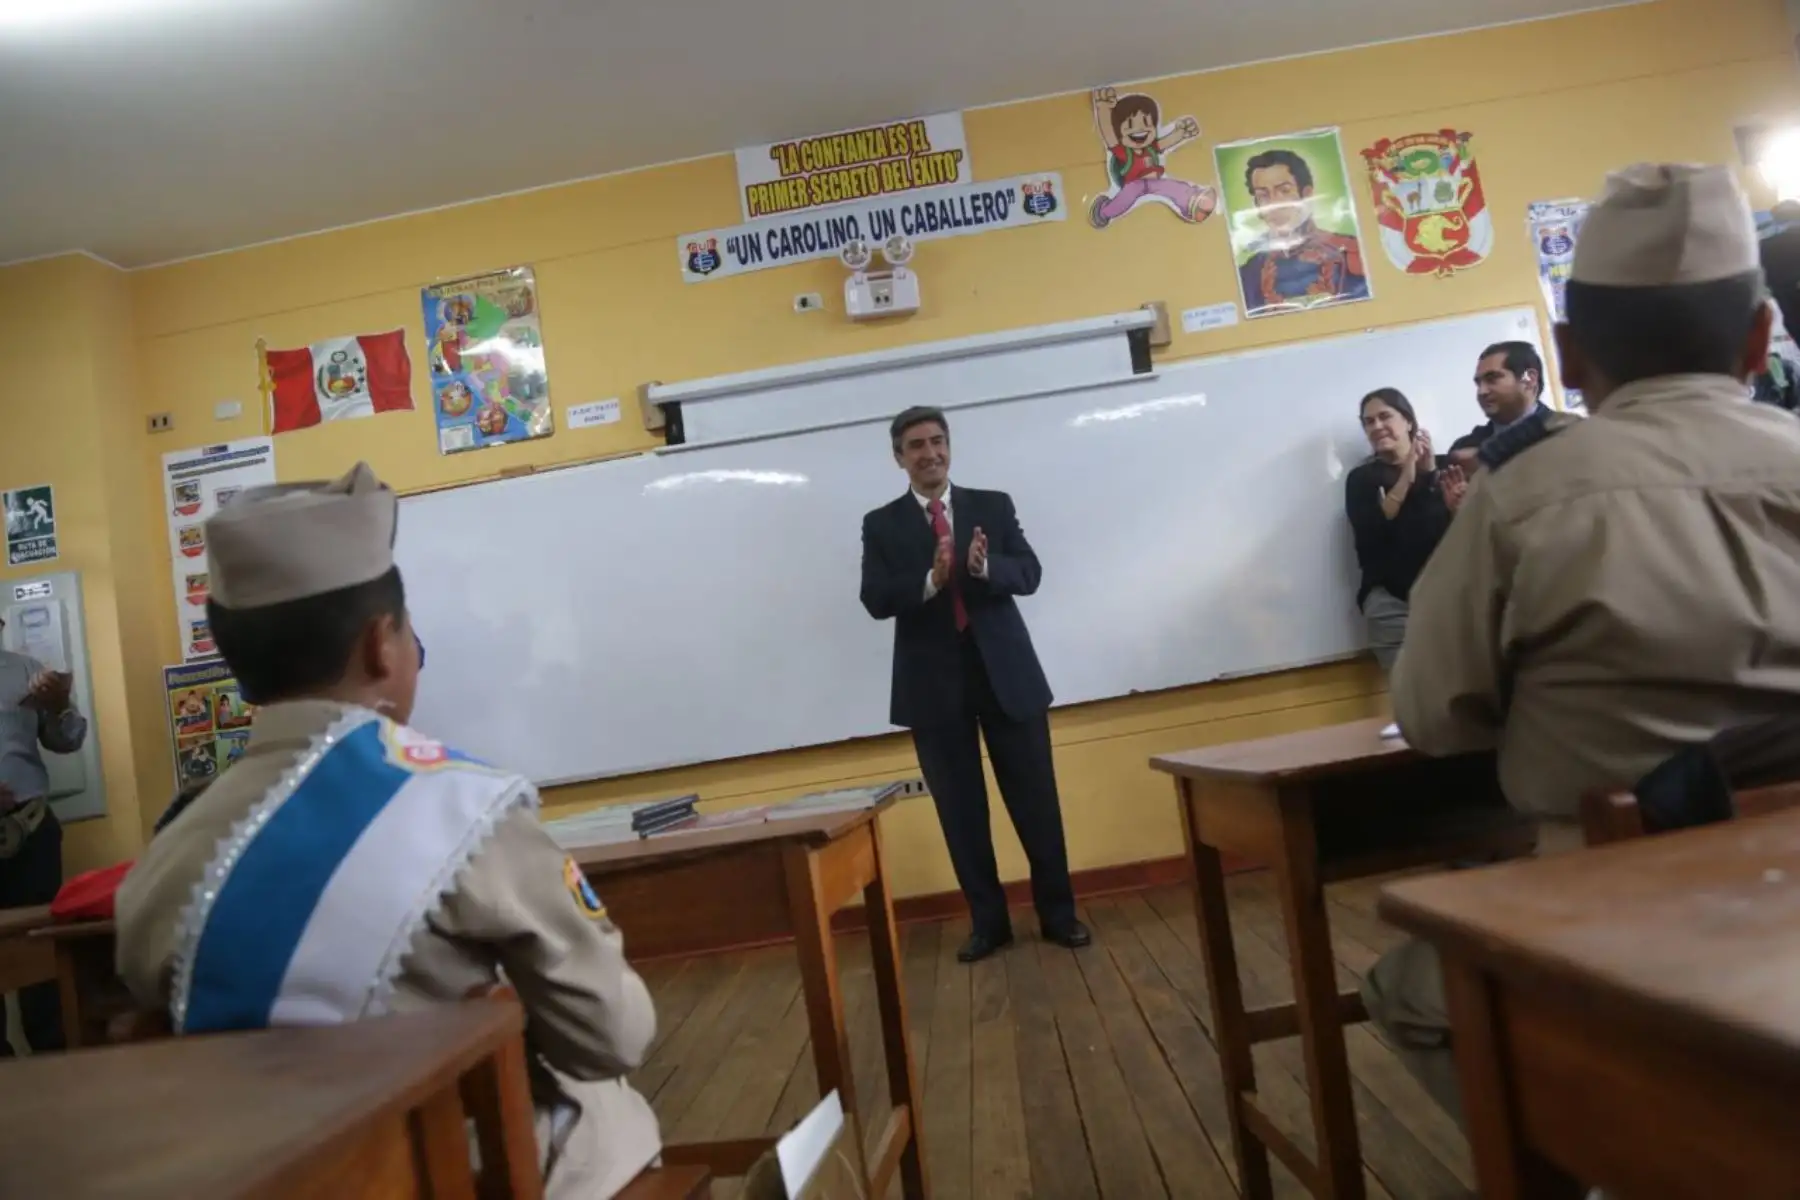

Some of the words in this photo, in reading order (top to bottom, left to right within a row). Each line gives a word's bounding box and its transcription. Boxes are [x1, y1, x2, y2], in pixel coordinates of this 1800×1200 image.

[770, 142, 803, 177] “LA
[799, 127, 891, 173] CONFIANZA
[885, 123, 910, 156] ES
[907, 120, 931, 154] EL
[746, 177, 811, 217] PRIMER
[808, 163, 881, 206] SECRETO
[879, 157, 911, 193] DEL
[726, 231, 763, 265] “UN
[868, 207, 897, 241] UN
[900, 187, 1016, 236] CABALLERO”
